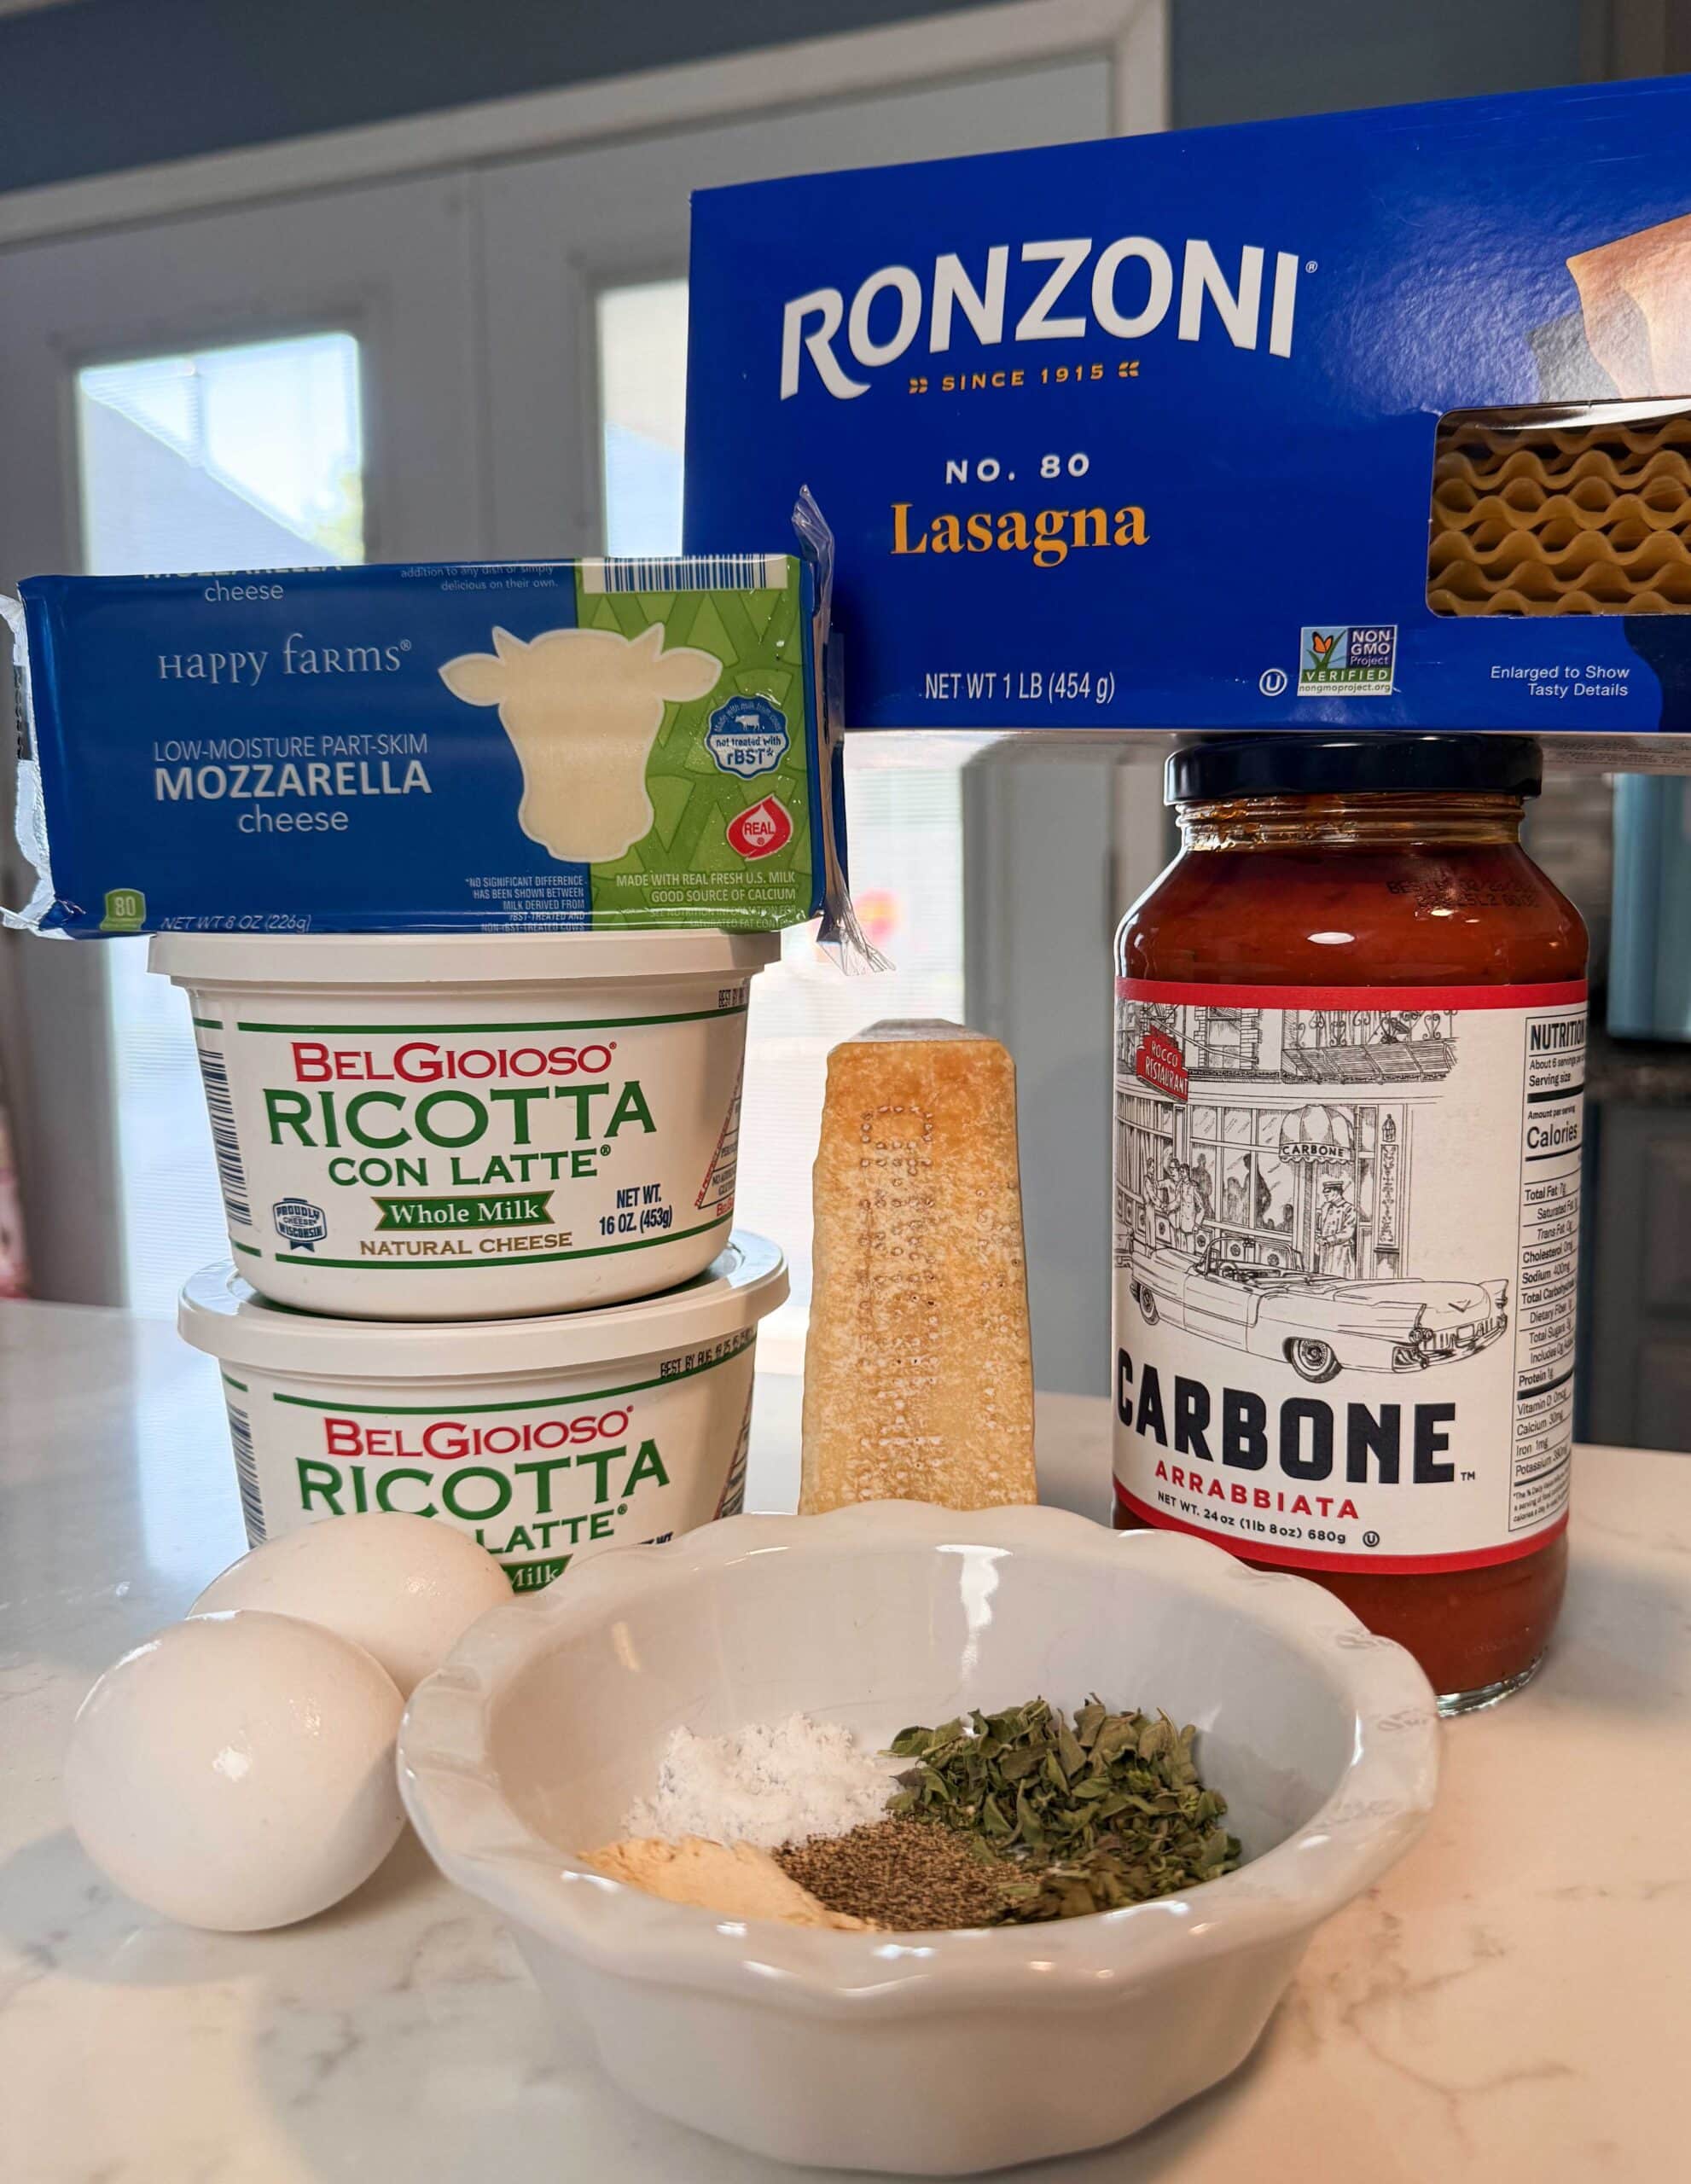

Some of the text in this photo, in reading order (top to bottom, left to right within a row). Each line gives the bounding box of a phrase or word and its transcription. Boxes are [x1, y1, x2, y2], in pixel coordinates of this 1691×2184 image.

[942, 364, 1104, 392] SINCE 1915
[944, 453, 1089, 484] NO. 80
[890, 502, 1150, 567] Lasagna
[204, 580, 284, 602] cheese
[441, 580, 486, 591] delicious
[506, 578, 529, 588] their
[1352, 630, 1392, 642] NON
[1351, 642, 1391, 655] GMO
[1351, 655, 1389, 667] Project
[1306, 669, 1388, 682] VERIFIED
[1491, 665, 1630, 682] Enlarged to Show
[925, 673, 962, 700] NET
[964, 673, 997, 699] WT
[1002, 673, 1012, 699] 1
[1016, 672, 1043, 698] LB
[1048, 671, 1092, 702] (454
[1299, 683, 1391, 694] nongmoproject.org
[1528, 682, 1629, 699] Tasty Details
[154, 734, 427, 762] LOW-MOISTURE PART-SKIM
[716, 735, 782, 746] not treated with
[154, 760, 432, 801] MOZZARELLA
[237, 804, 349, 834] cheese
[744, 822, 775, 835] REAL
[483, 876, 533, 887] SIGNIFICANT
[536, 875, 583, 886] DIFFERENCE
[616, 872, 795, 887] MADE WITH REAL FRESH U.S. MILK
[474, 887, 584, 899] HAS BEEN SHOWN BETWEEN
[652, 888, 795, 903] GOOD SOURCE OF CALCIUM
[114, 896, 136, 917] 80
[503, 899, 584, 910] MILK DERIVED FROM
[160, 916, 195, 929] NET
[196, 916, 224, 929] WT
[239, 915, 263, 929] OZ
[265, 914, 311, 932] (226g)
[1152, 1041, 1177, 1067] ROCCO
[1529, 1059, 1551, 1070] About
[1529, 1072, 1571, 1087] Serving size
[263, 1081, 657, 1149] RICOTTA
[1528, 1110, 1552, 1120] Amount
[1526, 1121, 1578, 1149] Calories
[1282, 1145, 1345, 1158] CARBONE
[328, 1157, 428, 1186] CON
[617, 1183, 661, 1208] NET WT.
[1525, 1187, 1545, 1201] Total
[1547, 1185, 1557, 1197] Fat
[276, 1205, 320, 1221] PROUDLY
[389, 1200, 539, 1223] Whole Milk
[1537, 1204, 1566, 1220] Saturated
[600, 1205, 672, 1235] 16 OZ. (453g)
[279, 1222, 323, 1238] WISCONSIN
[1537, 1228, 1555, 1240] Trans
[360, 1232, 572, 1256] NATURAL CHEESE
[1523, 1245, 1562, 1263] Cholesterol
[1522, 1269, 1551, 1284] Sodium
[1522, 1291, 1542, 1304] Total
[1530, 1310, 1553, 1324] Dietary
[1529, 1329, 1546, 1344] Total
[1519, 1371, 1546, 1386] Protein
[1517, 1399, 1545, 1416] Vitamin
[1517, 1419, 1547, 1437] Calcium
[1516, 1444, 1532, 1457] Iron
[1515, 1455, 1552, 1478] Potassium
[296, 1438, 670, 1520] RICOTTA
[1155, 1461, 1359, 1519] ARRABBIATA
[1158, 1490, 1177, 1507] NET
[1180, 1499, 1200, 1516] WT.
[1240, 1518, 1265, 1532] (1lb
[1308, 1529, 1345, 1544] 680g
